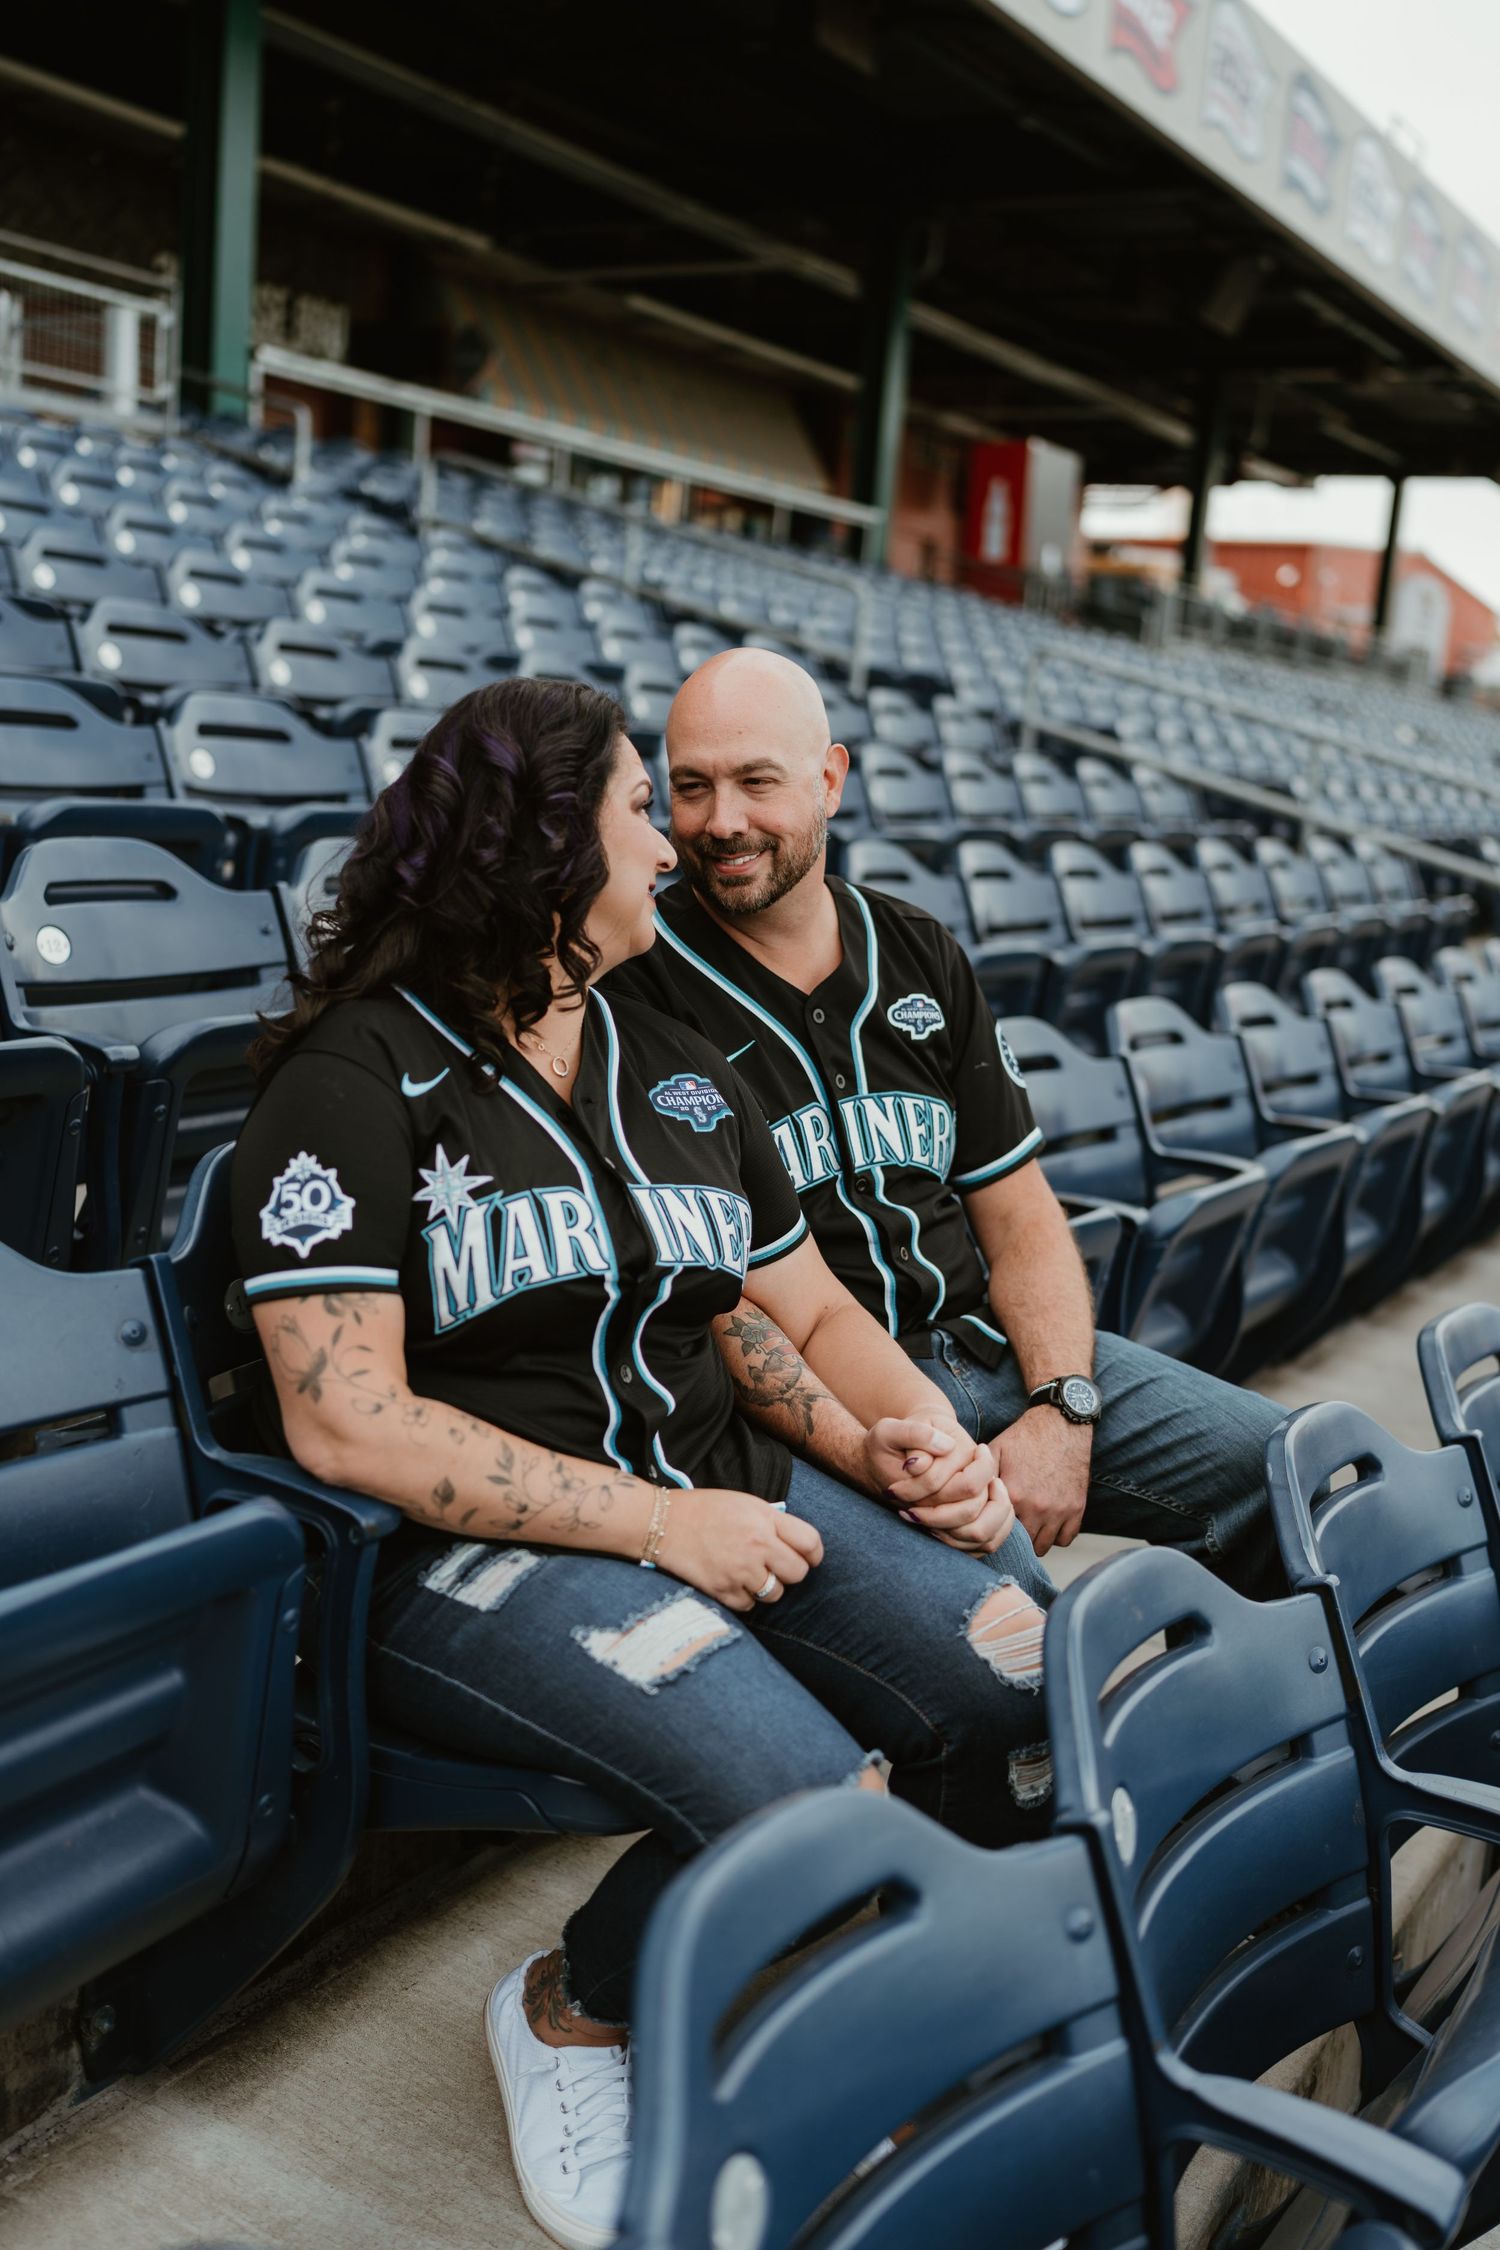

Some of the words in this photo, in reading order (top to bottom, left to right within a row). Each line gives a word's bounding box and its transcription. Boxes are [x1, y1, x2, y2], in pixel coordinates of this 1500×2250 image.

[656, 1094, 725, 1106] CHAMPION
[768, 1090, 957, 1195] ARINER
[280, 1180, 332, 1215] 50
[421, 1183, 752, 1336] MARINER
